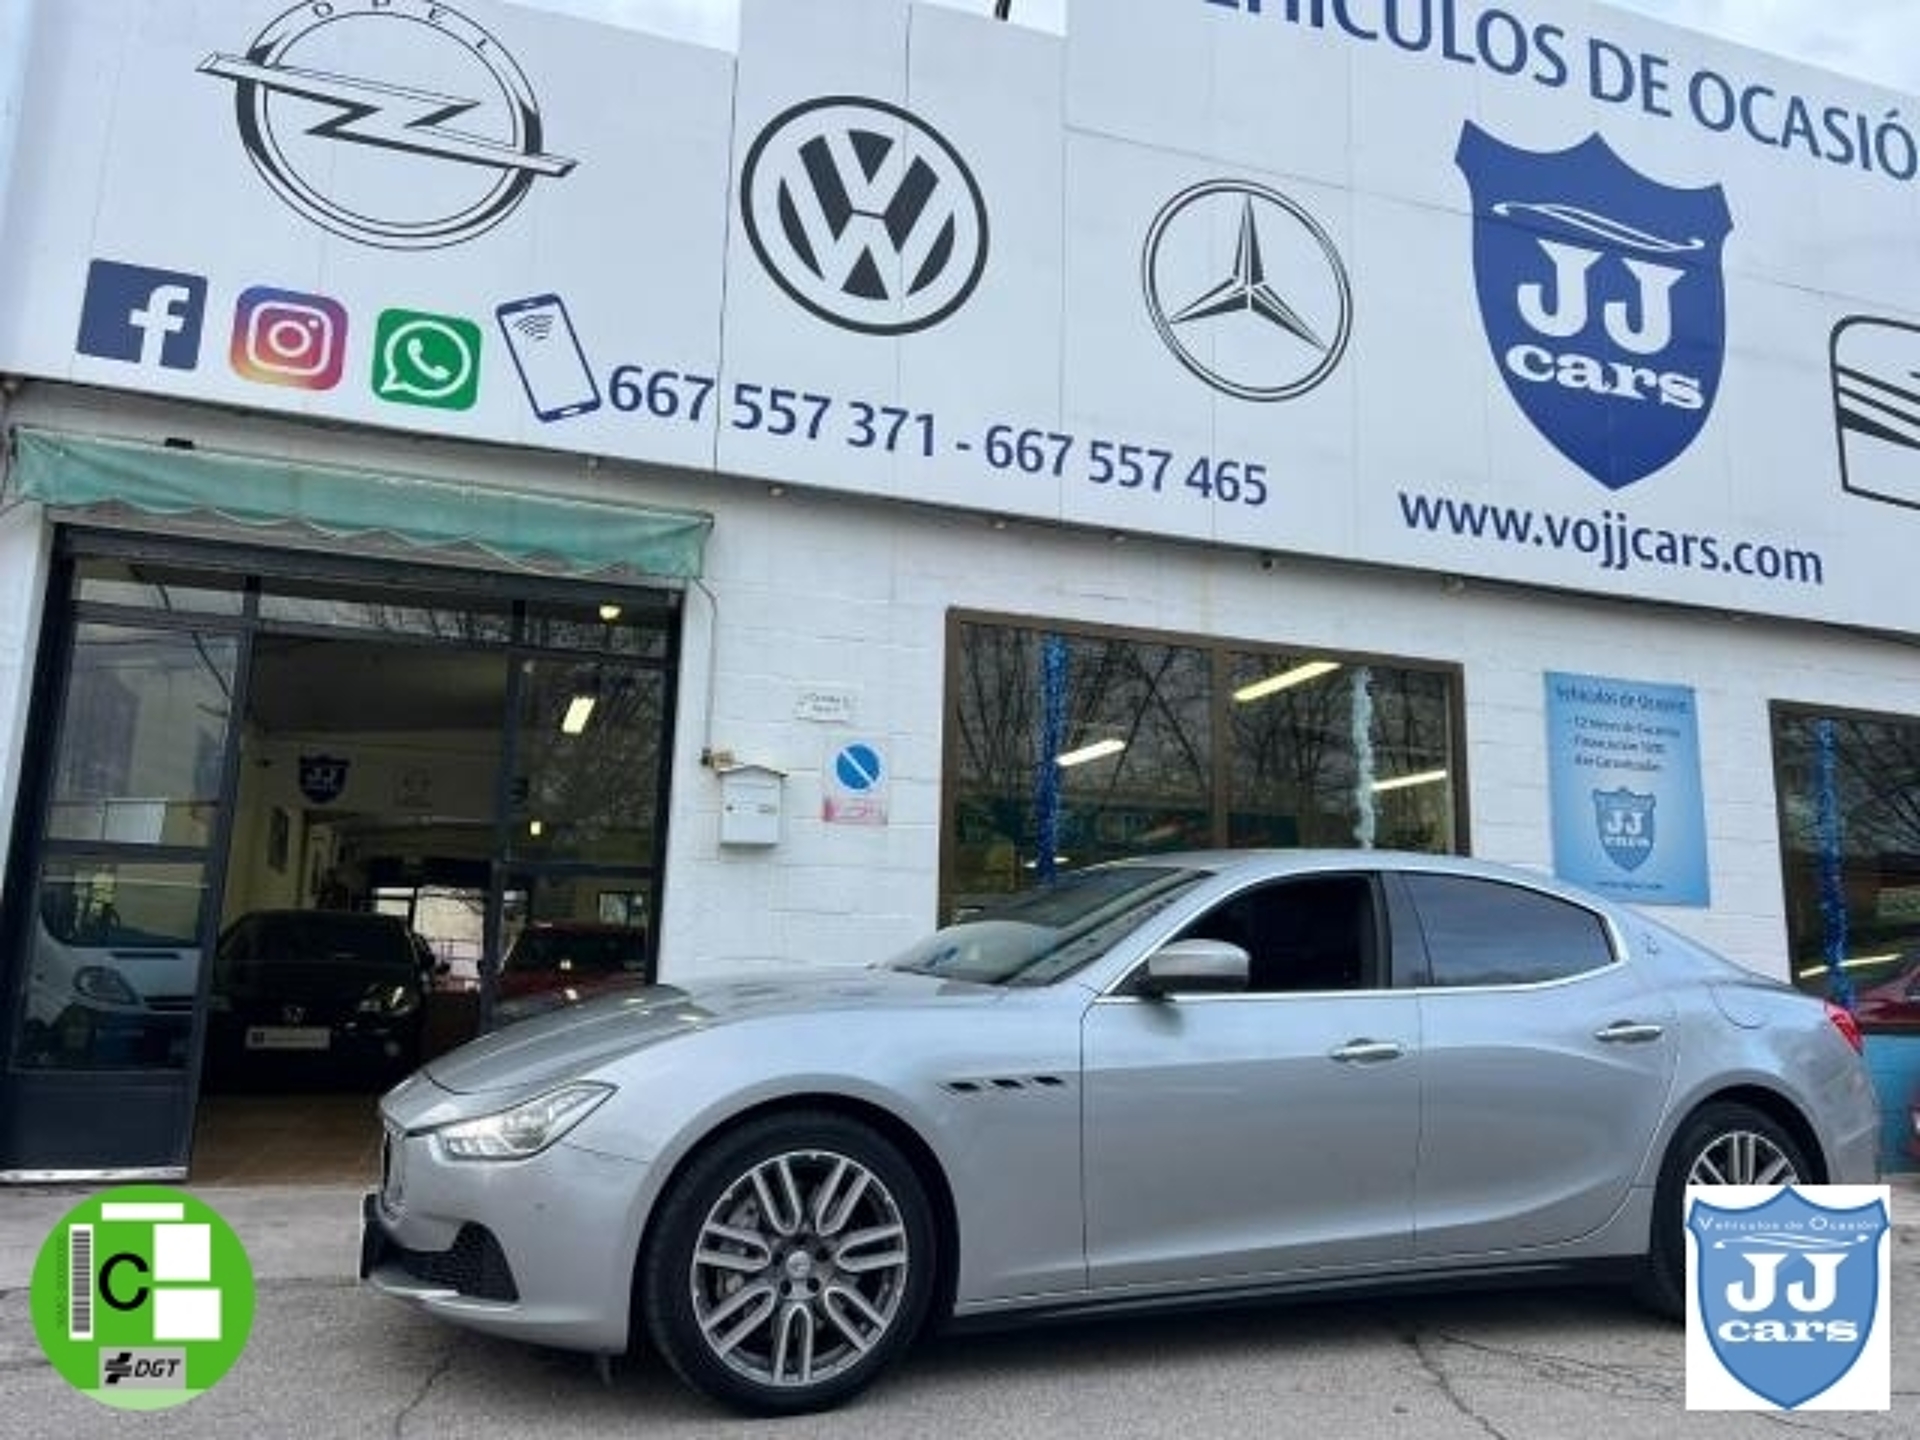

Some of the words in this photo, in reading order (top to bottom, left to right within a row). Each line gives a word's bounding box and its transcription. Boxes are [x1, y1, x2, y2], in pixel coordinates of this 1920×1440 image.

[1203, 0, 1568, 87] CULOS
[1589, 38, 1672, 118] DE
[1688, 70, 1918, 181] OCASIÓ
[1516, 237, 1688, 355] JJ
[1505, 343, 1705, 410] cars
[608, 364, 715, 421] 667
[732, 382, 832, 440] 557
[846, 400, 935, 457] 371
[985, 424, 1075, 478] 667
[1088, 440, 1173, 493] 557
[1185, 455, 1268, 506] 465
[1397, 491, 1824, 586] www.vojjcars.com
[1607, 811, 1645, 835] JJ
